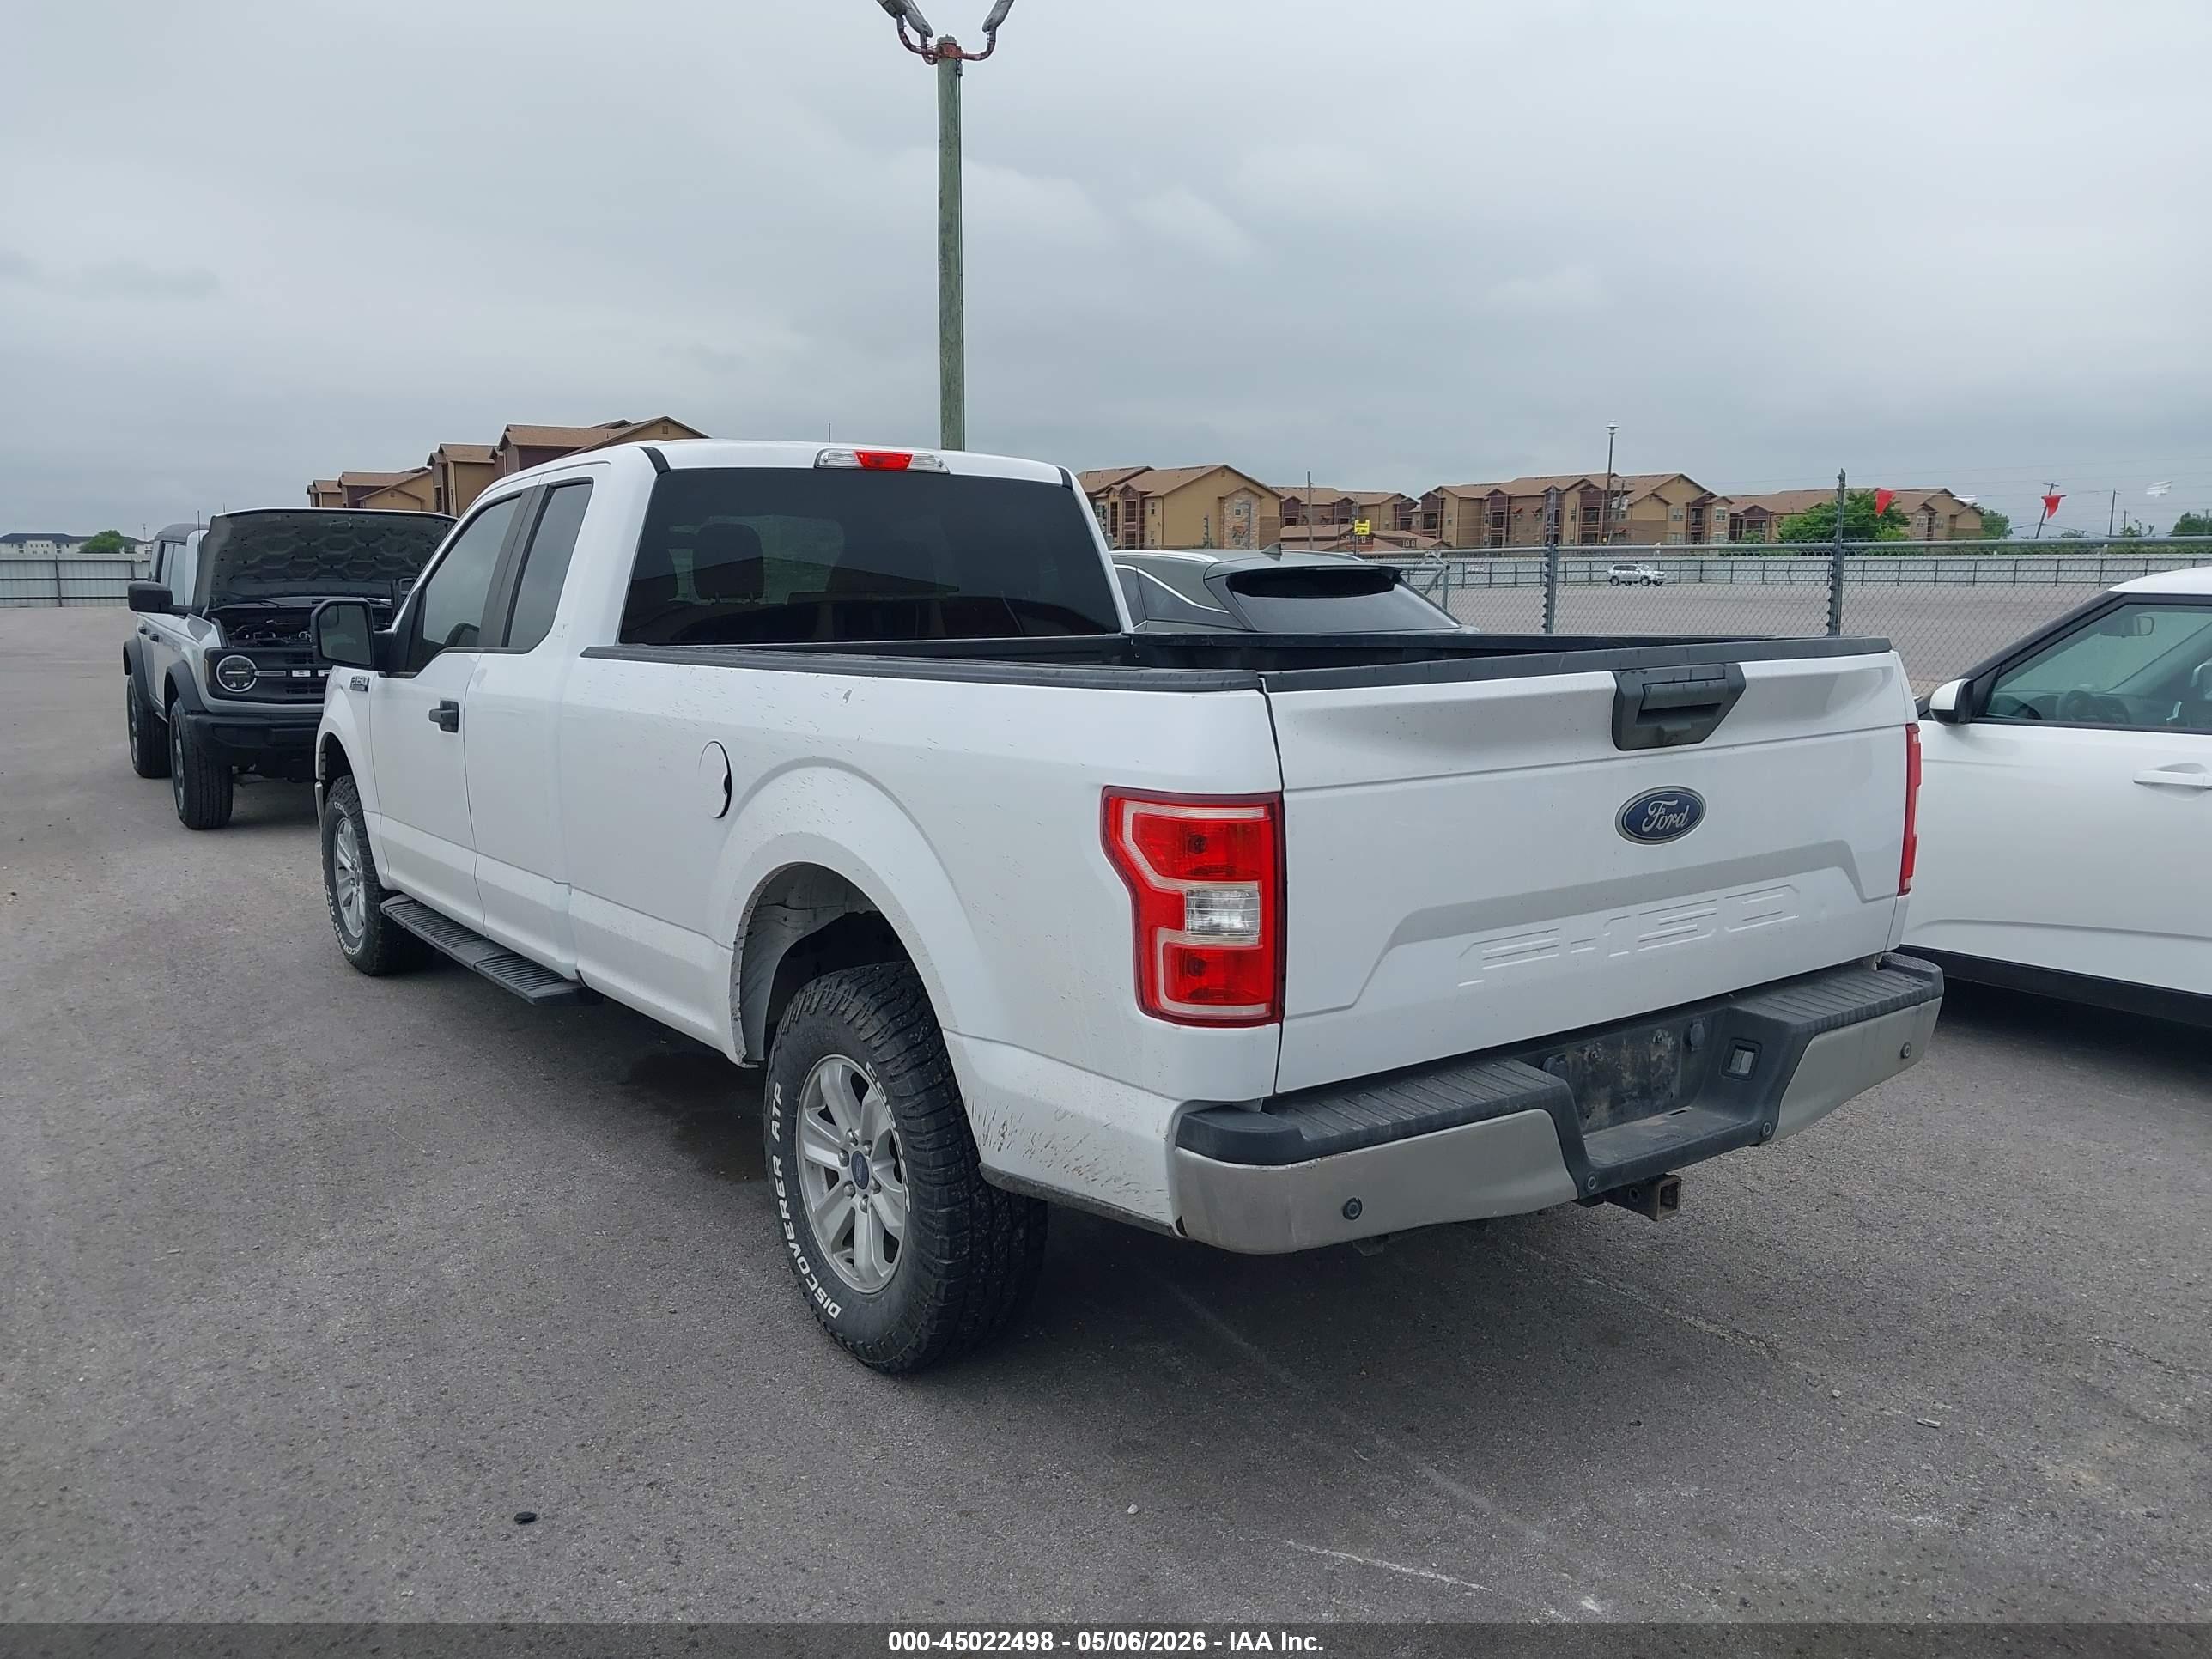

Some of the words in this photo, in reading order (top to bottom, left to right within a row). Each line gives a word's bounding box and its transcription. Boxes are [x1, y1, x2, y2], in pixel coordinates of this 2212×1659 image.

[1641, 799, 1690, 832] Ford
[771, 1082, 783, 1143] ATP
[773, 1154, 842, 1319] DISCOVERER
